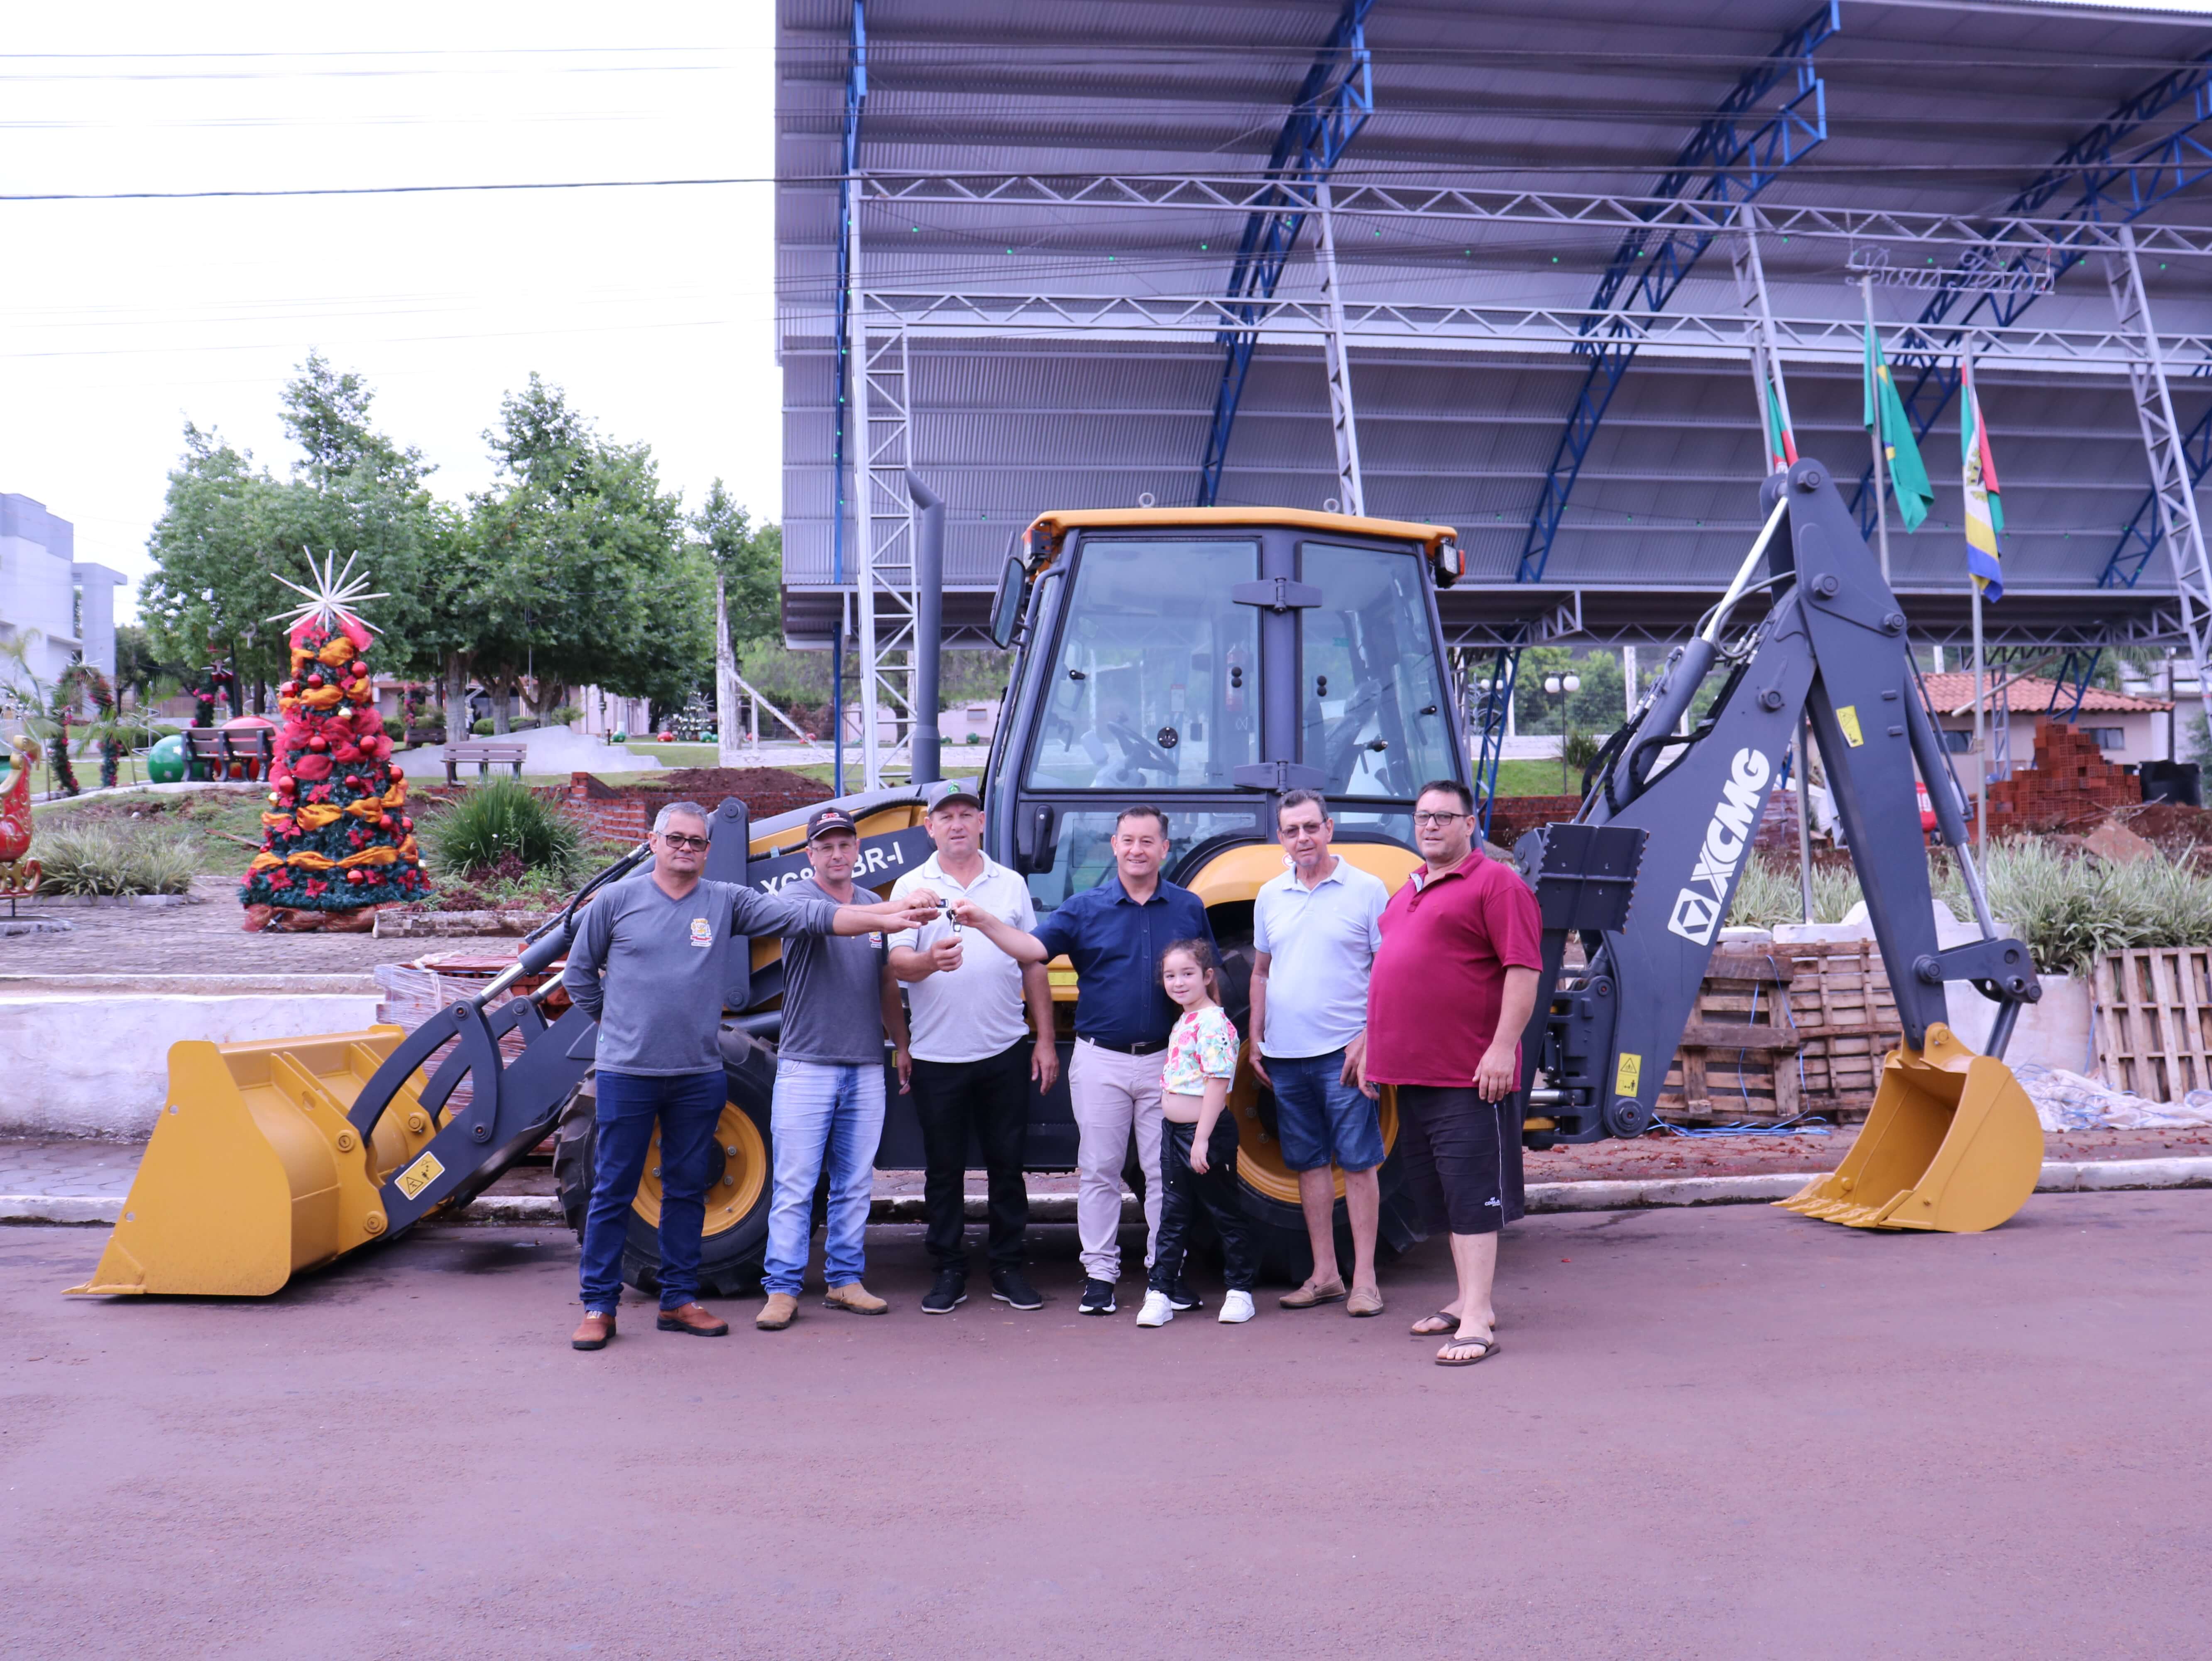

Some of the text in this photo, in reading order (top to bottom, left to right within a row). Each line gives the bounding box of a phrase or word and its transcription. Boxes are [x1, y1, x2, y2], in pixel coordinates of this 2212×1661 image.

[1691, 748, 1770, 905] XCMG
[760, 841, 904, 896] XC8BR-I
[587, 1311, 602, 1319] CAT
